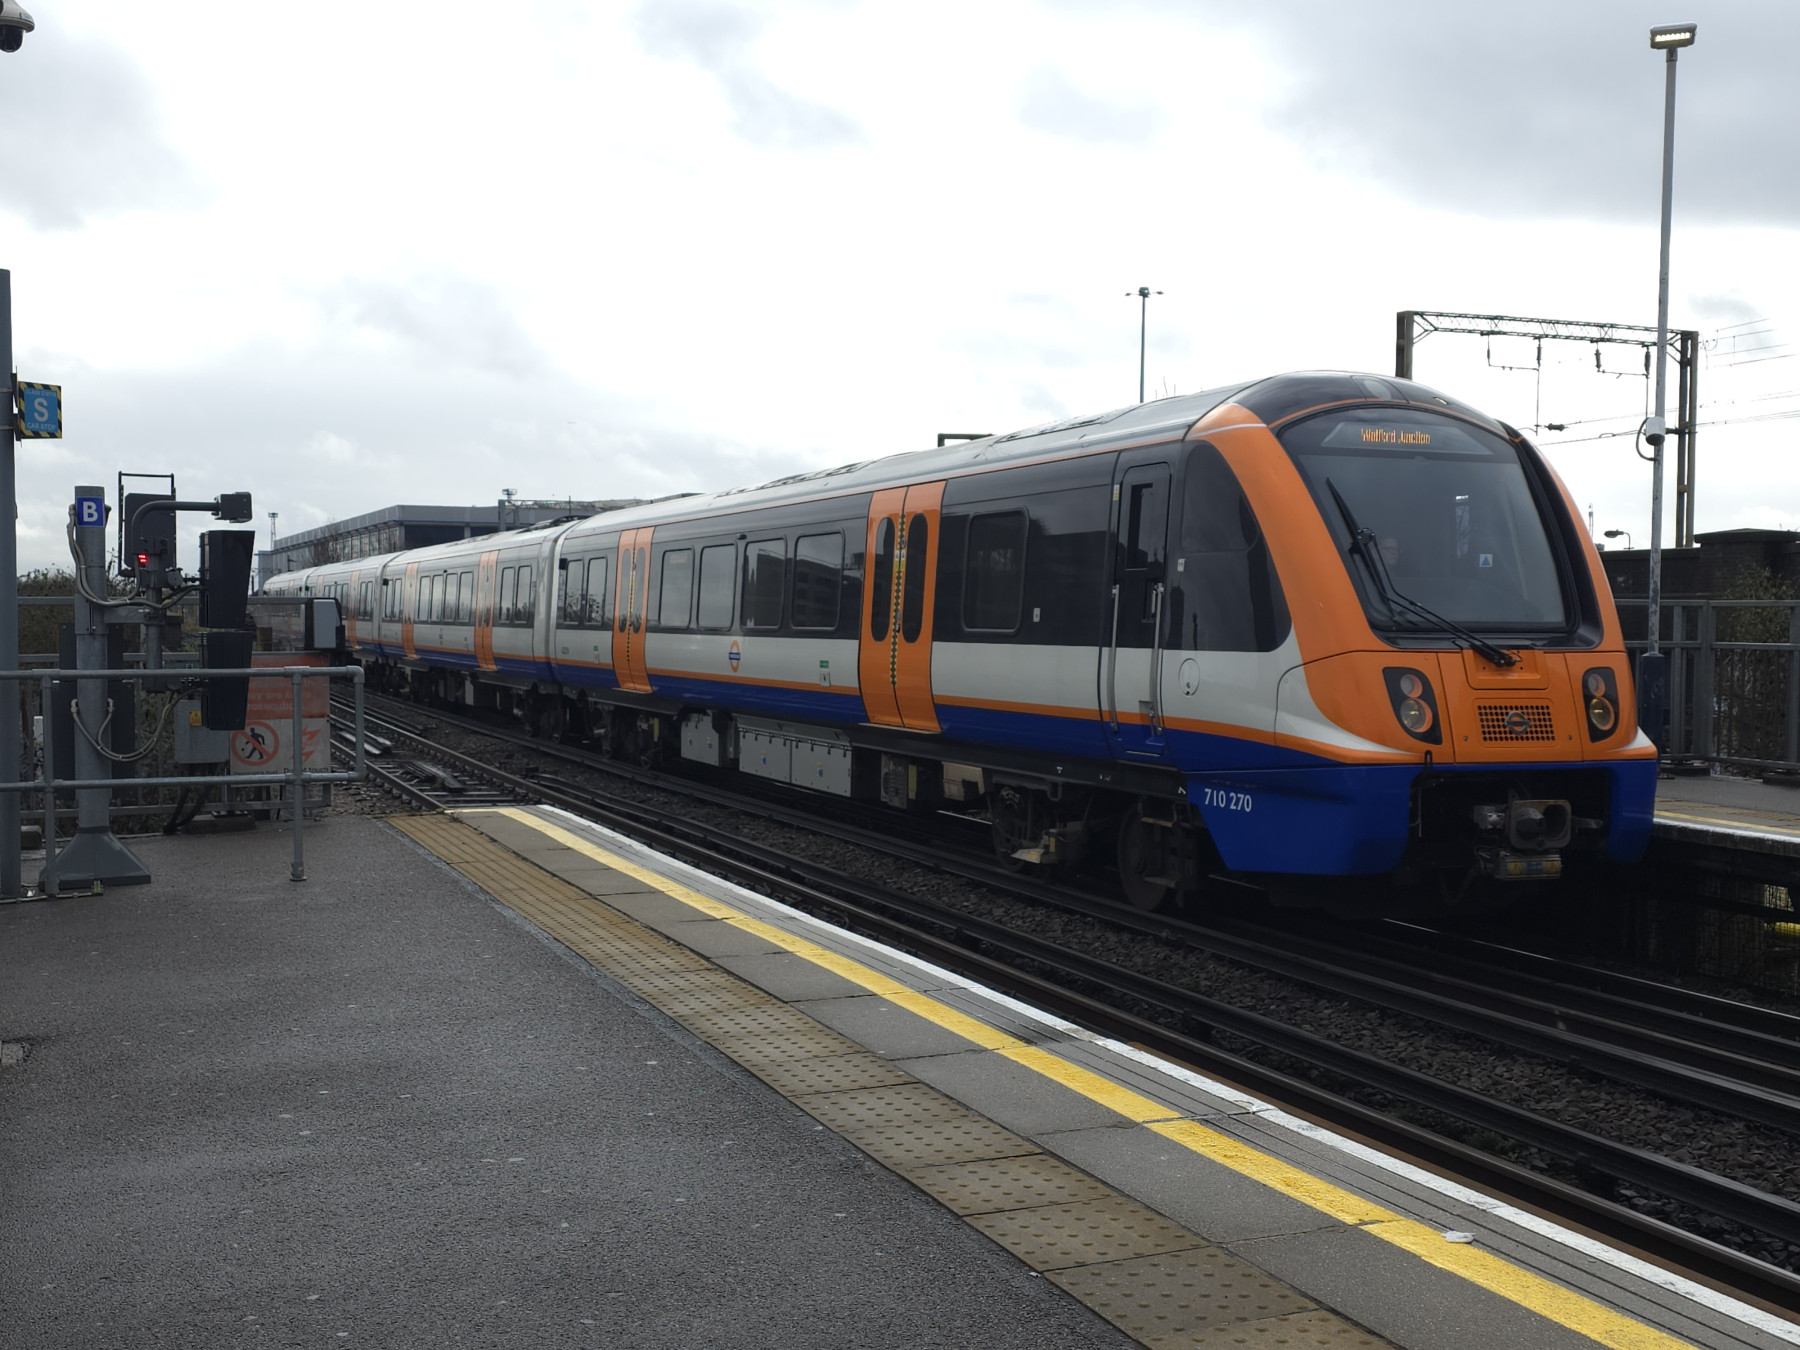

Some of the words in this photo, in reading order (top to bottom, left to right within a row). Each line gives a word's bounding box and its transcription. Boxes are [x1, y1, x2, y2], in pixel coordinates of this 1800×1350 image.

[34, 397, 48, 422] S
[1398, 430, 1431, 445] Junction
[82, 501, 98, 522] B
[1204, 788, 1226, 808] 710
[1230, 792, 1252, 812] 270
